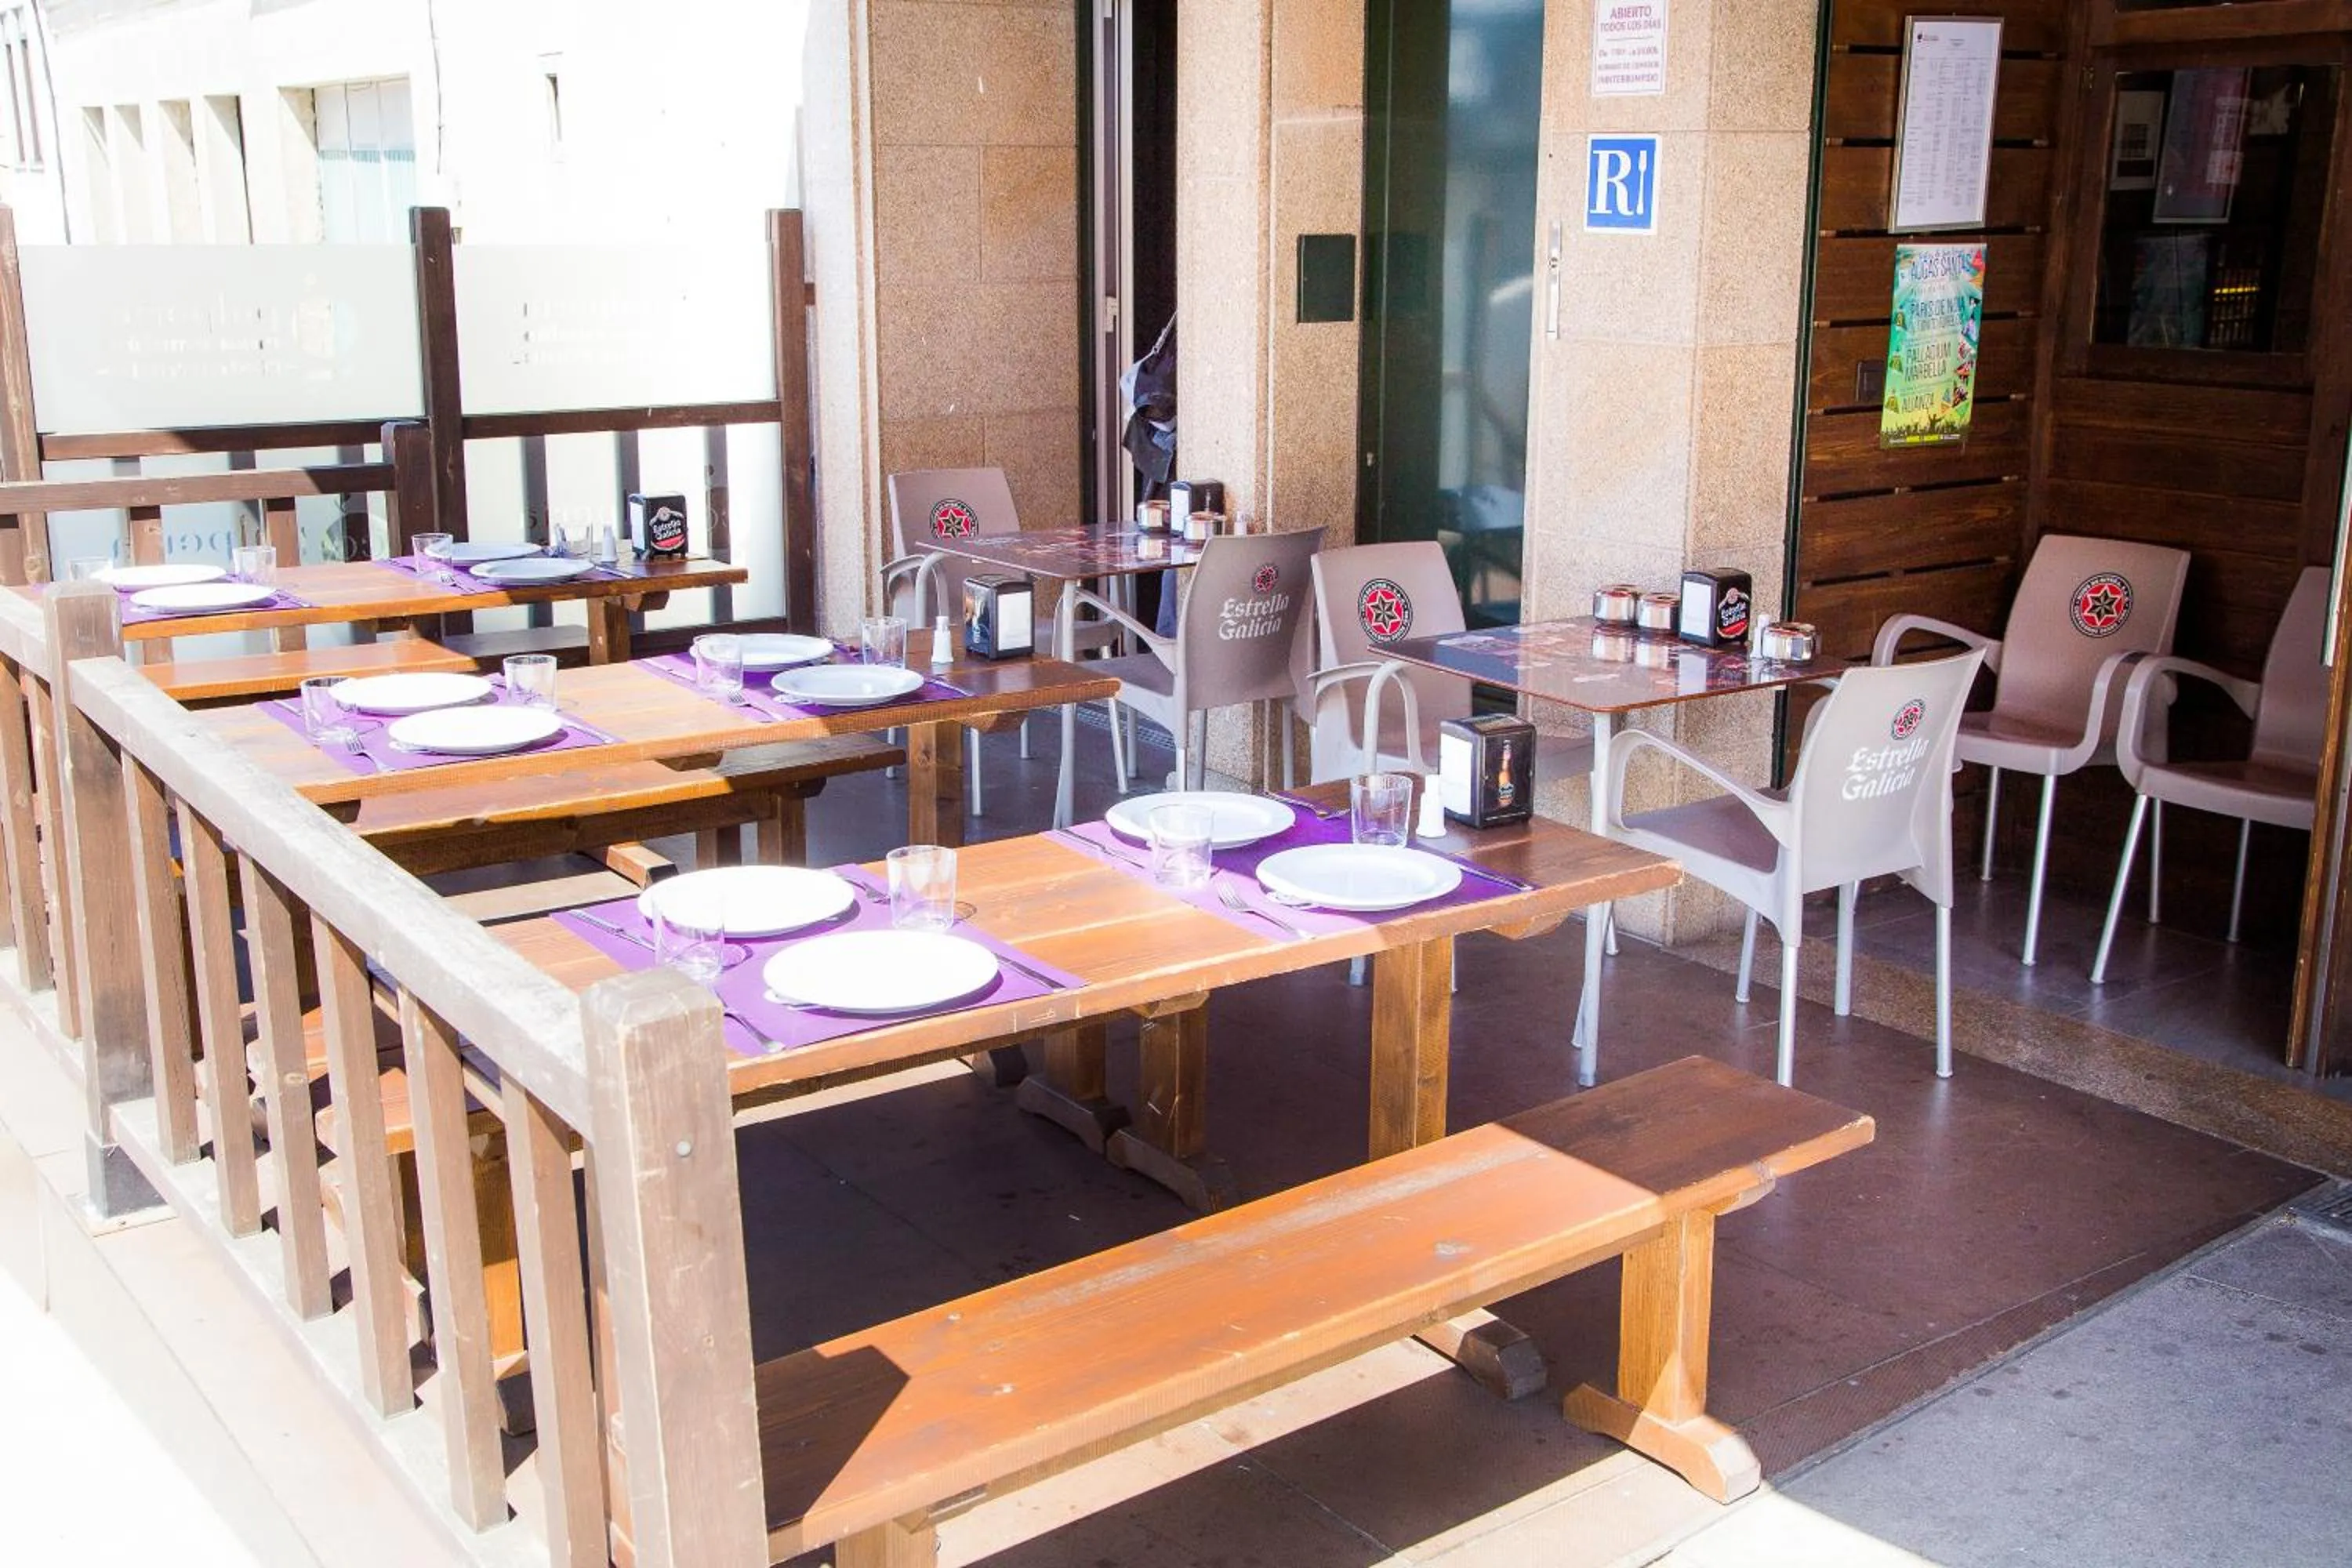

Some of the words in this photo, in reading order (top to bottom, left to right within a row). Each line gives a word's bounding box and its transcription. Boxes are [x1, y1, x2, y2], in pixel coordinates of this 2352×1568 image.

[1610, 5, 1652, 19] ABIERTO
[1219, 593, 1290, 619] Estrella
[1218, 614, 1282, 641] Galicia
[1845, 739, 1930, 772] Estrella
[1841, 765, 1915, 801] Galicia
